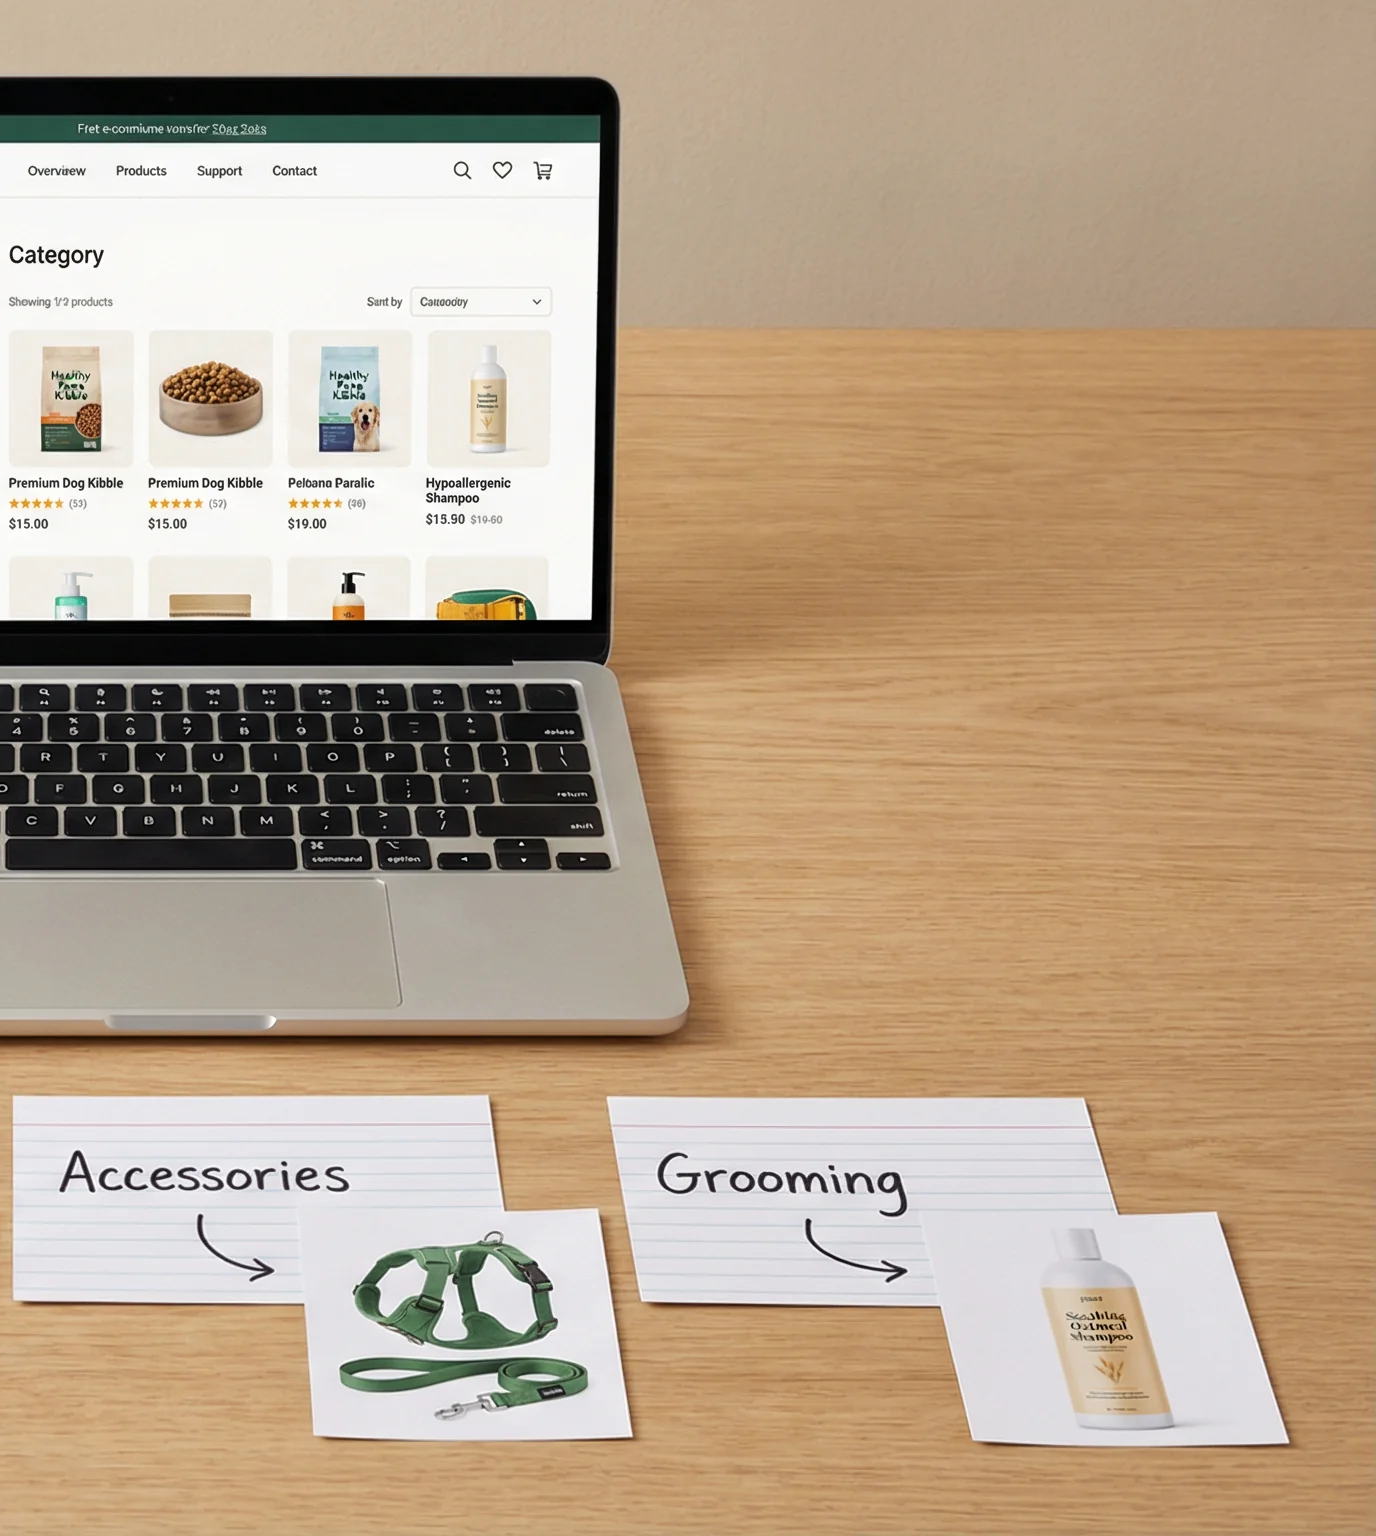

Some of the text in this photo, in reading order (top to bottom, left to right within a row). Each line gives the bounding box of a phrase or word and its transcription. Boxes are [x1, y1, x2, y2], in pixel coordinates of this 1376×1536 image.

[116, 164, 168, 177] Products
[197, 165, 243, 179] Support
[272, 164, 318, 177] Contact
[10, 245, 104, 268] Category
[8, 296, 52, 310] Showing
[71, 296, 114, 309] products
[390, 296, 403, 310] by
[8, 476, 124, 492] Premium Dog Kibble
[148, 476, 264, 492] Premium Dog Kibble
[426, 477, 511, 491] Hypoallergenic
[426, 492, 479, 506] Shampoo
[8, 517, 49, 531] $15.00
[147, 517, 188, 531] $15.00
[287, 516, 327, 531] $19.00
[425, 512, 466, 526] $15.90
[12, 726, 22, 735] 4
[40, 752, 51, 762] R
[98, 752, 108, 762] T
[155, 752, 166, 762] Y
[212, 752, 224, 762] U
[385, 752, 395, 762] P
[230, 783, 239, 793] J
[287, 783, 298, 793] K
[345, 783, 356, 793] L
[26, 815, 38, 826] C
[84, 815, 97, 826] V
[201, 815, 214, 825] N
[260, 815, 274, 825] M
[59, 1150, 349, 1192] Accessories
[658, 1153, 907, 1217] Grooming
